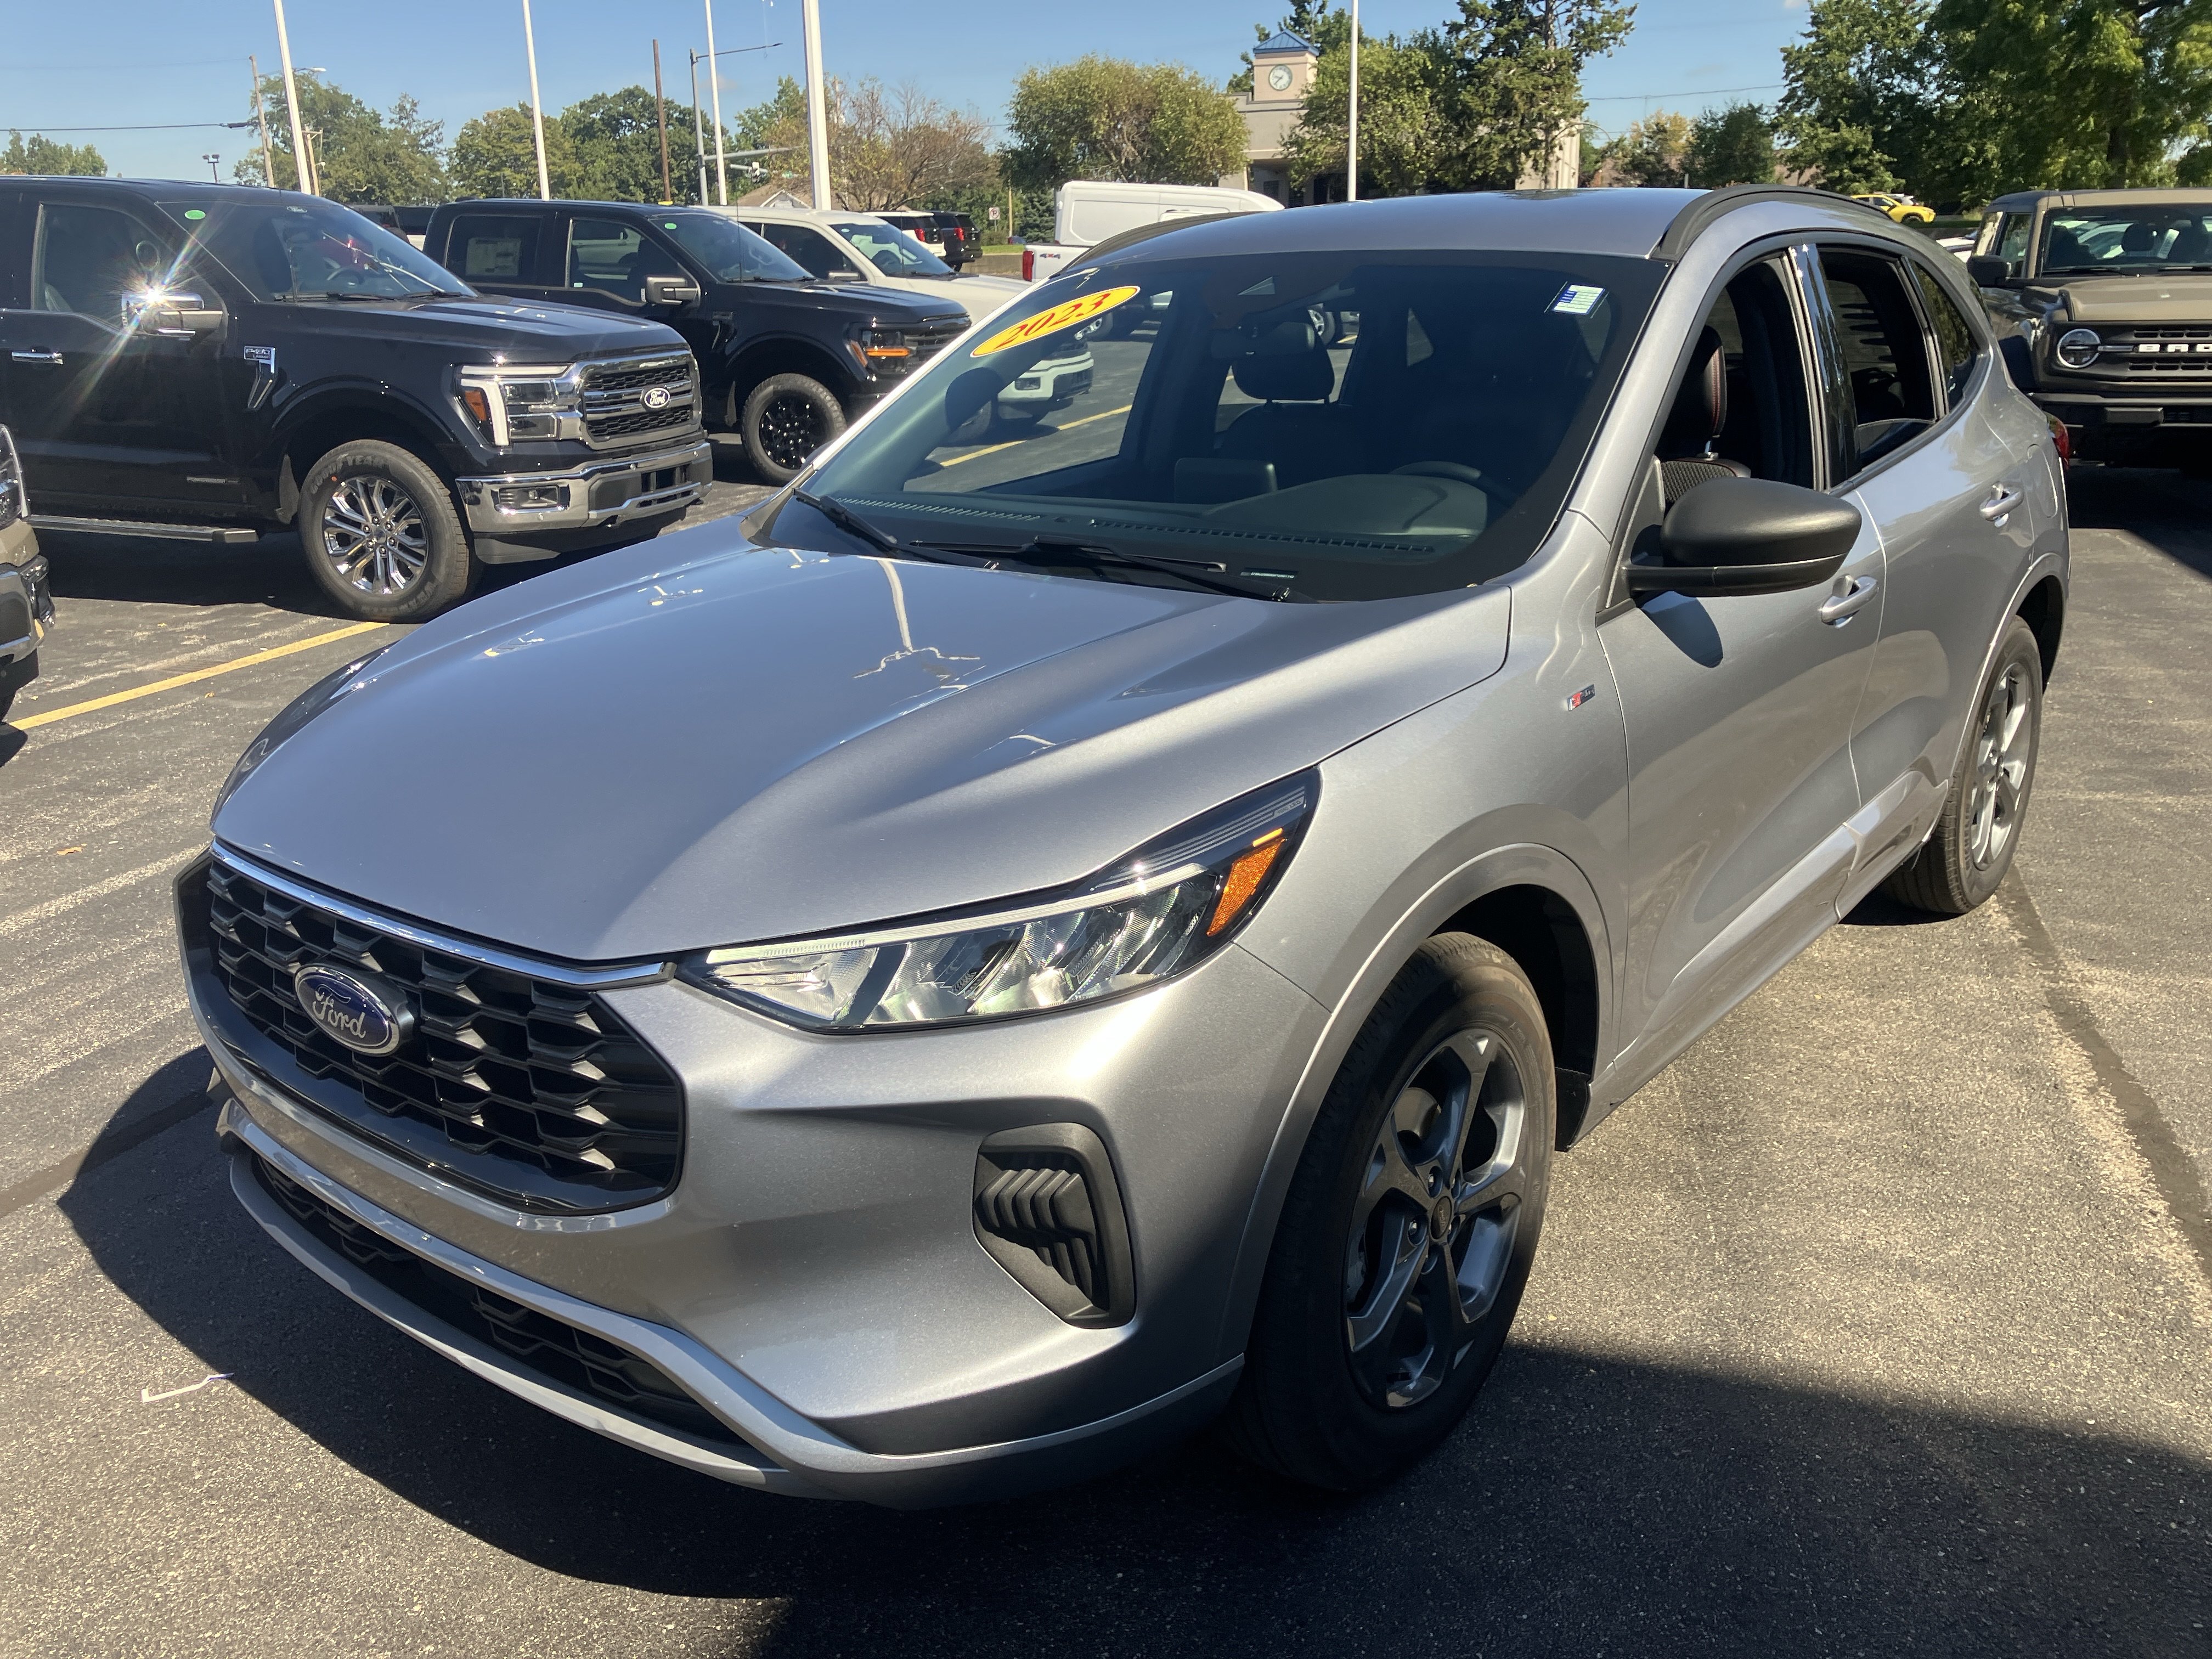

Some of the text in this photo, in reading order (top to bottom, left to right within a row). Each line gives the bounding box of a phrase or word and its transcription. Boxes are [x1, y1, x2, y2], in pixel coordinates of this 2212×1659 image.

[993, 293, 1111, 349] 2023
[650, 391, 665, 405] Ford
[313, 984, 366, 1039] Ford
